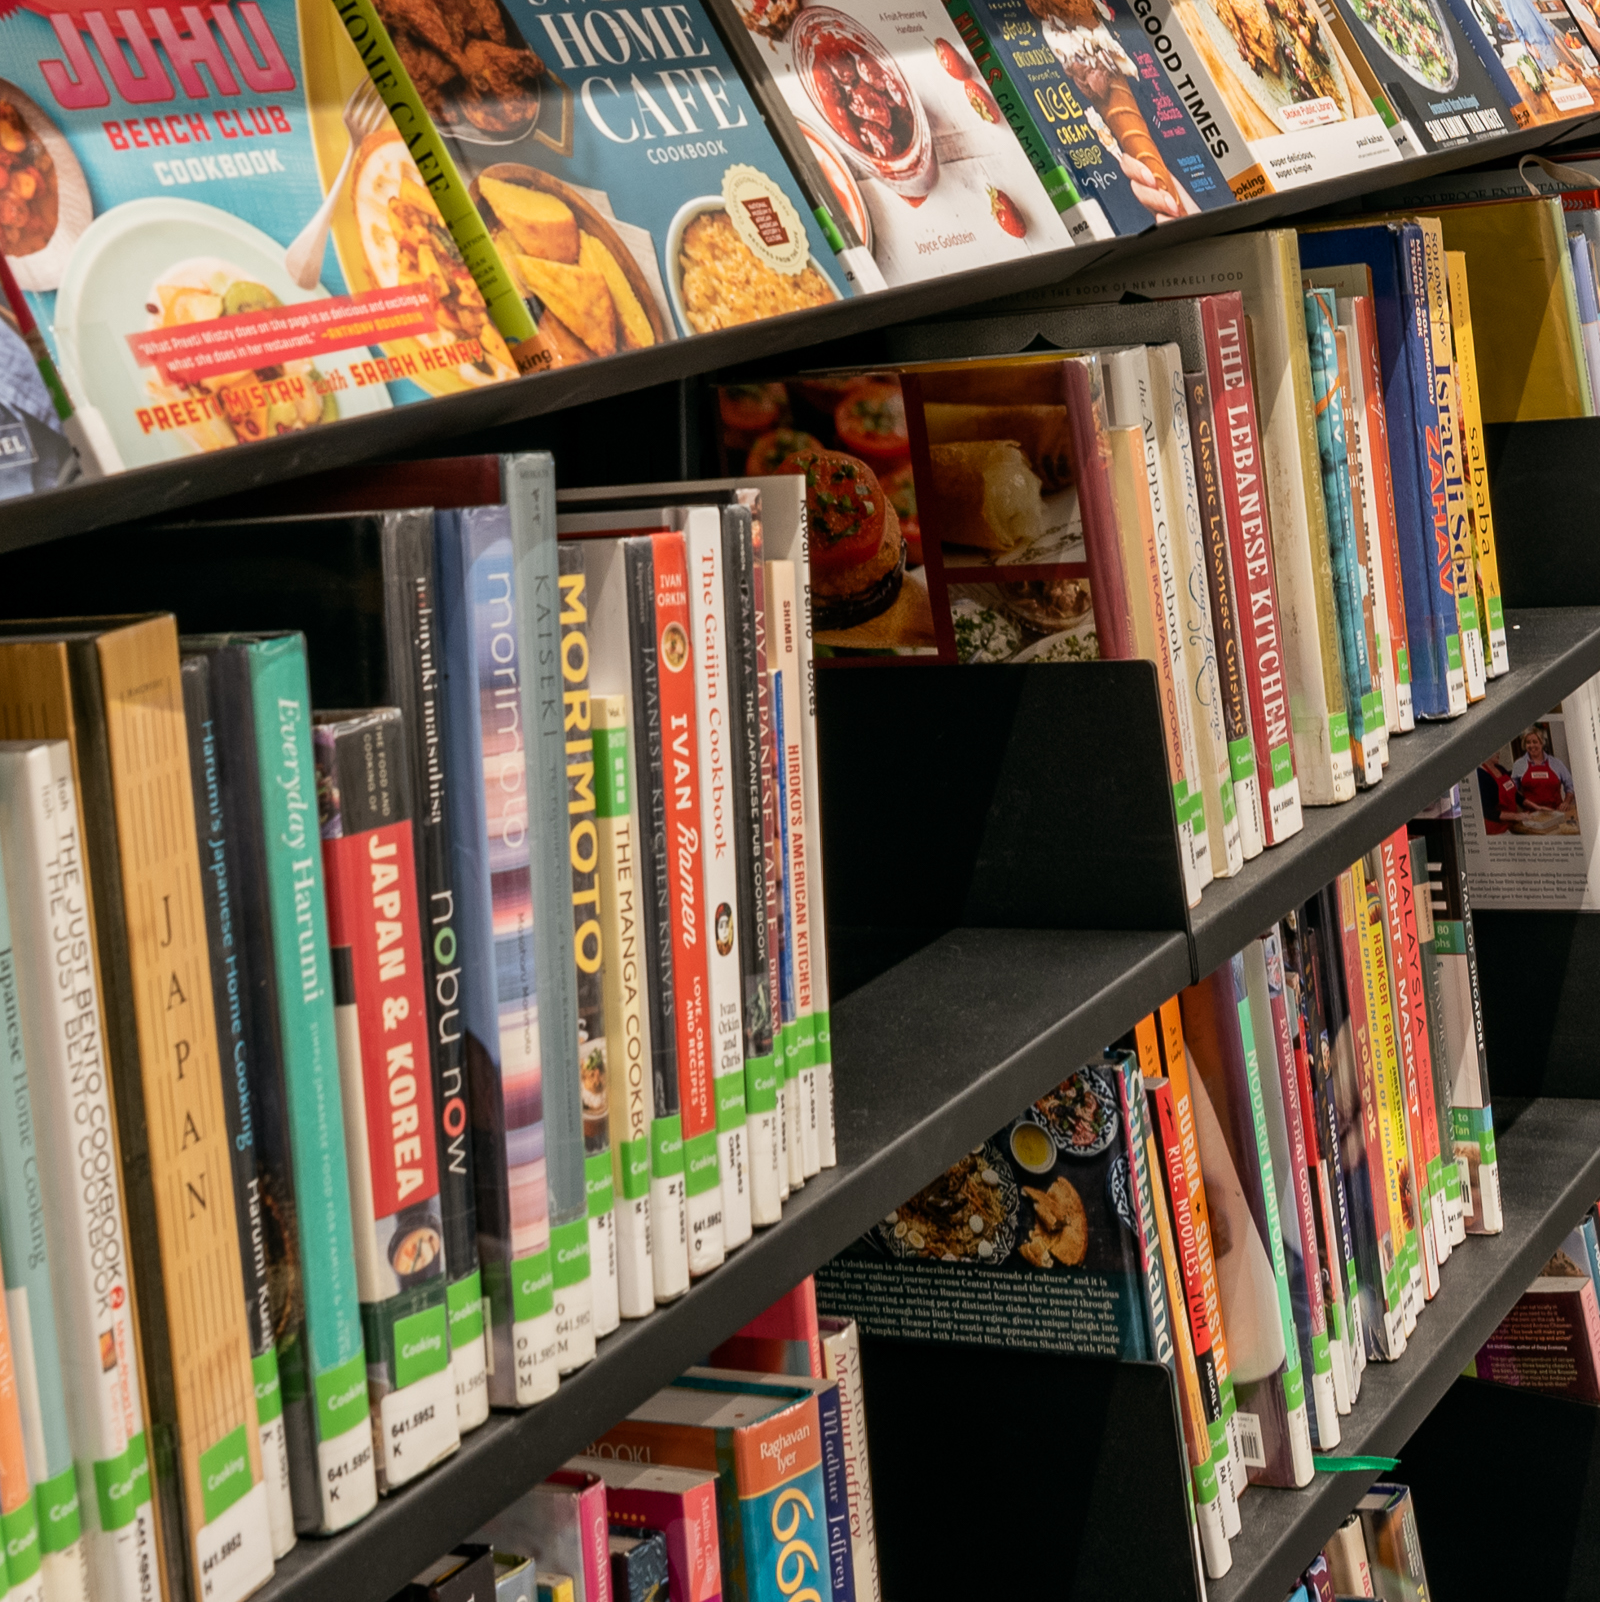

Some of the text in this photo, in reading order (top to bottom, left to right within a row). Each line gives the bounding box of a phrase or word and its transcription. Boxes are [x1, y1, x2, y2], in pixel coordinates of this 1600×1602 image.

[39, 0, 298, 110] JUHU
[536, 4, 711, 70] HOME
[951, 11, 1004, 90] HILLS
[103, 105, 292, 153] BEACH CLUB
[579, 64, 750, 146] CAFE
[1033, 82, 1083, 123] ICE
[1056, 123, 1095, 145] CREAM
[1179, 75, 1231, 161] TIMES
[1356, 134, 1385, 149] paul kahan
[152, 148, 286, 187] COOKBOOK
[646, 140, 729, 166] COOKBOOK
[1069, 145, 1103, 170] SHOP
[1269, 151, 1317, 169] super delicious,
[1275, 163, 1313, 180] super simple
[915, 229, 977, 256] Joyce Goldstein
[1132, 270, 1245, 291] NEW ISRAELI FOOD
[136, 338, 483, 434] PREETI MISTRY with SARAH HENRY
[1424, 424, 1456, 597] ZAHAV
[1466, 423, 1493, 559] sababa
[1217, 317, 1289, 746] THE LEBANESE KITCHEN
[657, 593, 686, 607] ORKIN
[659, 574, 682, 589] IVAN
[487, 570, 528, 851] morimoto
[701, 548, 728, 861] The Gaijin Cookbook
[558, 573, 604, 974] MORIMOTO
[783, 600, 812, 1009] SHIMBO HIROKO'S AMERICAN KITCHEN
[274, 697, 326, 1006] Everyday Harumi
[670, 714, 699, 950] IVAN Ramen
[1382, 842, 1421, 1119] NIGHT MARKET
[1397, 853, 1429, 1039] MALAYSIA
[158, 895, 210, 1220] JAPAN
[367, 834, 426, 1202] JAPAN & KOREA
[431, 889, 469, 1177] nobu now
[1123, 1067, 1177, 1364] Samarkand
[1176, 1093, 1229, 1390] BURMA SUPERSTAR
[940, 1288, 1113, 1311] Russians passed through
[961, 1278, 1120, 1299] Central Asia Various
[1036, 1306, 1115, 1321] Caroline Eden, who
[390, 1404, 436, 1440] 641.5952
[758, 1425, 811, 1459] Raghavan
[776, 1450, 797, 1476] Iyer
[822, 1405, 846, 1590] Madhur Jaffrey
